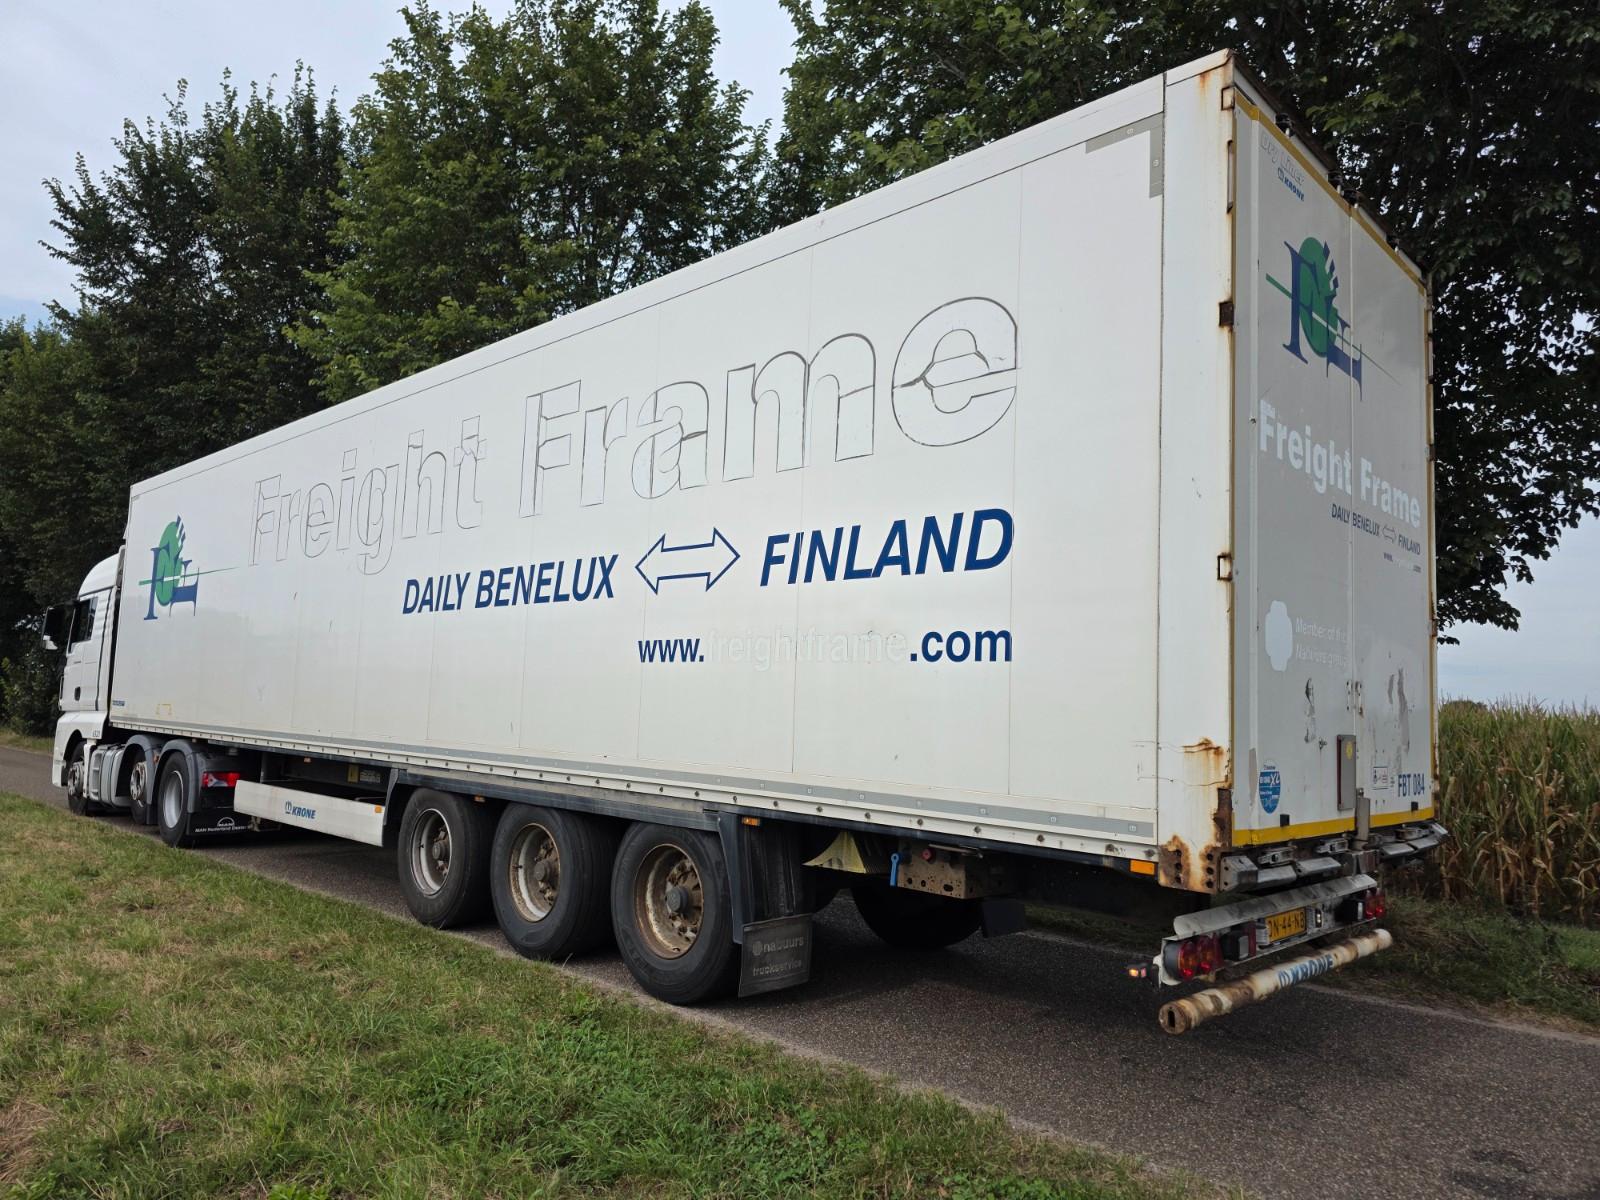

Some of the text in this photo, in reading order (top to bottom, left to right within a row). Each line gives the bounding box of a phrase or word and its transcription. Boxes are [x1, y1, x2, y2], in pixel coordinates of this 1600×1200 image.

[1284, 177, 1305, 202] KRONE
[247, 296, 1018, 575] Freight Frame
[1260, 399, 1421, 529] Freight Frame
[1331, 503, 1421, 556] DAILY BENELUX FINLAND
[402, 508, 1015, 615] DAILY BENELUX FINLAND
[1398, 773, 1412, 798] FBT
[1413, 772, 1425, 797] 084
[292, 806, 317, 819] KRONE
[1290, 953, 1334, 984] KRONE
